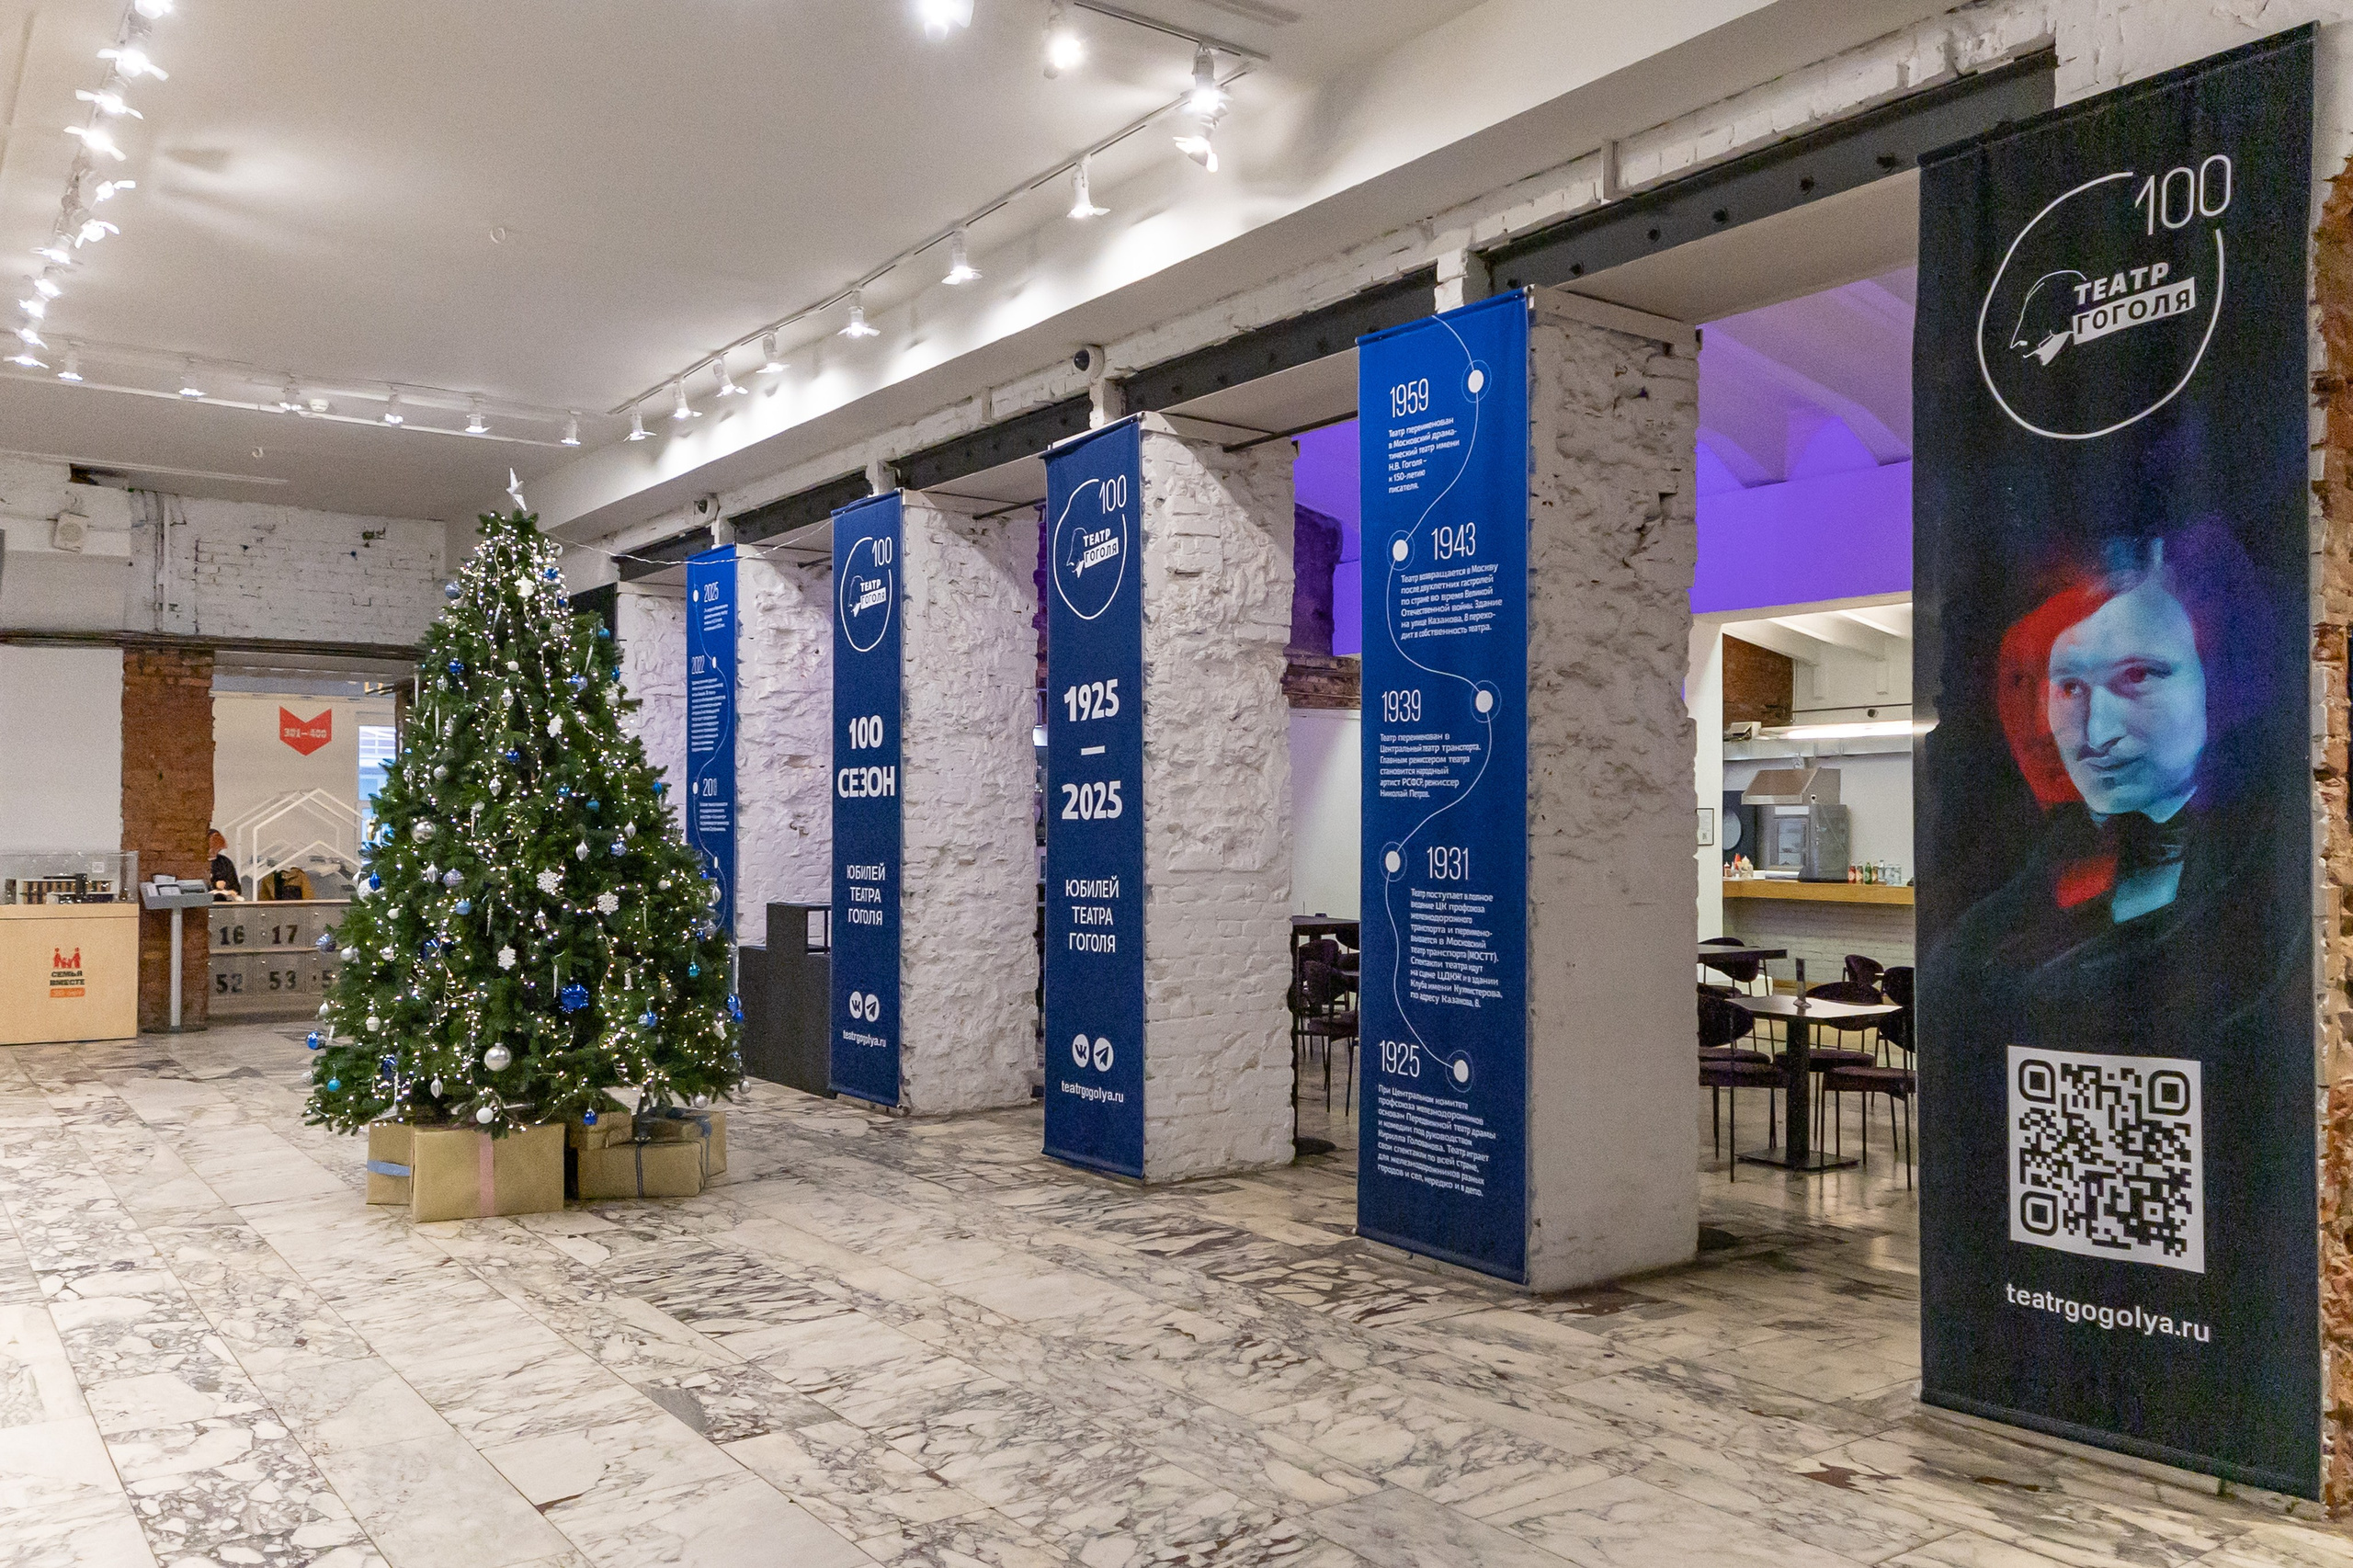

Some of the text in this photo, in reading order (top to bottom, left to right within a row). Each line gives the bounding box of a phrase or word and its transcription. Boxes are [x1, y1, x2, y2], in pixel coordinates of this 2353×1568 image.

[2135, 154, 2231, 235] 100
[2075, 263, 2168, 305] ТЕАТР
[2075, 289, 2191, 335] ГОГОЛЯ
[1390, 379, 1428, 418] 1959
[1389, 417, 1454, 437] Театр переименован
[1393, 434, 1430, 448] Московский
[1431, 429, 1457, 440] драма-
[1389, 440, 1460, 460] тический театр имени
[1389, 459, 1422, 471] Н.В. Гоголя
[1393, 470, 1426, 482] 150-летию
[1099, 474, 1126, 514] 100
[1389, 483, 1419, 494] писателя.
[1083, 528, 1110, 547] ТЕАТР
[1431, 522, 1476, 561] 1943
[871, 537, 892, 567] 100
[1085, 542, 1118, 563] ГОГОЛЯ
[1401, 574, 1418, 583] Театр
[1419, 569, 1466, 581] возвращается
[1472, 564, 1498, 574] Москву
[1461, 574, 1494, 587] гастролей
[704, 581, 719, 603] 2025
[860, 579, 881, 592] ТЕАТР
[861, 592, 885, 605] ГОГОЛЯ
[1401, 604, 1449, 617] Отечественной
[1475, 598, 1503, 608] Здание
[1441, 593, 1463, 602] время
[1419, 628, 1467, 638] собственность
[1469, 624, 1492, 633] театра.
[1063, 678, 1119, 722] 1925
[1381, 689, 1421, 722] 1939
[849, 715, 882, 750] 100
[1380, 733, 1396, 743] Театр
[1380, 744, 1421, 755] Центральный
[1422, 744, 1439, 753] театр
[1449, 756, 1470, 765] театра
[838, 766, 895, 798] СЕЗОН
[1061, 780, 1122, 820] 2025
[1380, 789, 1408, 797] Николай
[847, 863, 885, 881] ЮБИЛЕЙ
[1427, 846, 1469, 881] 1931
[849, 886, 881, 903] ТЕАТРА
[1065, 876, 1120, 899] ЮБИЛЕЙ
[1427, 892, 1463, 901] поступает
[848, 908, 882, 925] ГОГОЛЯ
[1072, 905, 1114, 926] ТЕАТРА
[1449, 903, 1485, 914] профсоюза
[272, 925, 298, 944] 17
[1069, 932, 1116, 953] ГОГОЛЯ
[1446, 937, 1486, 949] Московский
[1411, 947, 1499, 963] театр транспорта (МОСТТ).
[1411, 956, 1443, 968] Спектакли
[1445, 961, 1468, 971] театра
[216, 973, 243, 994] 52
[269, 971, 296, 990] 53
[1472, 977, 1498, 985] здании
[843, 1029, 886, 1047] teatrgogolya.ru
[1379, 1040, 1420, 1077] 1925
[1061, 1080, 1123, 1103] teatrgogolya.ru
[1379, 1085, 1469, 1110] При Центральном комитете
[1379, 1097, 1483, 1125] профсоюза железнодорожников
[1379, 1108, 1496, 1140] основан Передвижной театр драмы
[1383, 1120, 1413, 1133] комедии
[1414, 1127, 1425, 1136] под
[1426, 1131, 1472, 1146] руководством
[1378, 1129, 1405, 1142] Кирилла
[1447, 1144, 1466, 1158] Театр
[1467, 1151, 1489, 1162] играет
[1378, 1142, 1392, 1151] свои
[1393, 1145, 1427, 1160] спектакли
[1437, 1156, 1454, 1165] всей
[1378, 1153, 1390, 1162] для
[1461, 1173, 1484, 1186] разных
[1378, 1164, 1404, 1176] городов
[1411, 1172, 1424, 1182] сел,
[1425, 1176, 1453, 1188] нередко
[2006, 1283, 2210, 1343] teatrgogolya.ru
